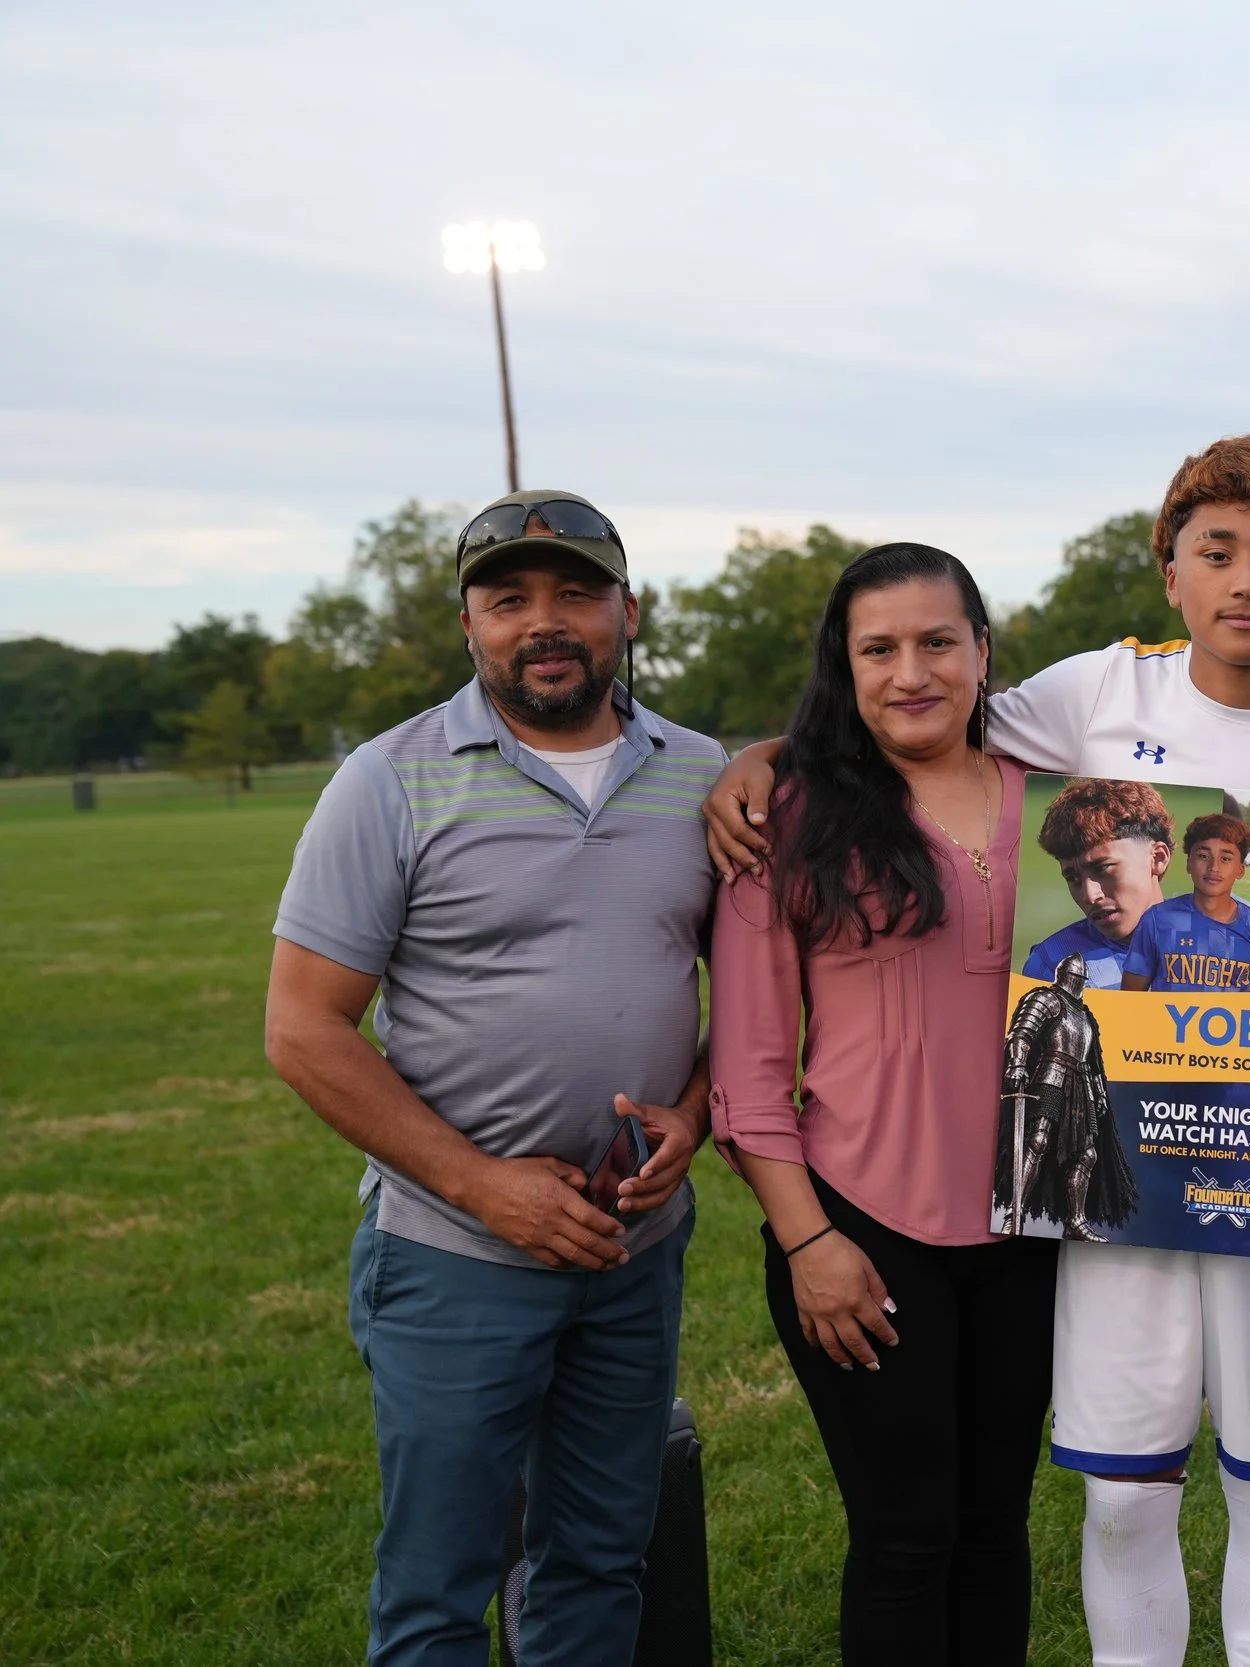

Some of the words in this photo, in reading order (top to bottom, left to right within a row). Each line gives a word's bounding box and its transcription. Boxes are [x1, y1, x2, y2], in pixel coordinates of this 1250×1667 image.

[1122, 1049, 1185, 1066] VARSITY
[1188, 1054, 1229, 1069] BOYS
[1140, 1100, 1198, 1122] YOUR
[1138, 1122, 1214, 1144] WATCH
[1139, 1144, 1158, 1154] BUT
[1159, 1145, 1188, 1157] ONCE
[1189, 1148, 1198, 1157] A
[1199, 1149, 1239, 1162] KNIGHT,
